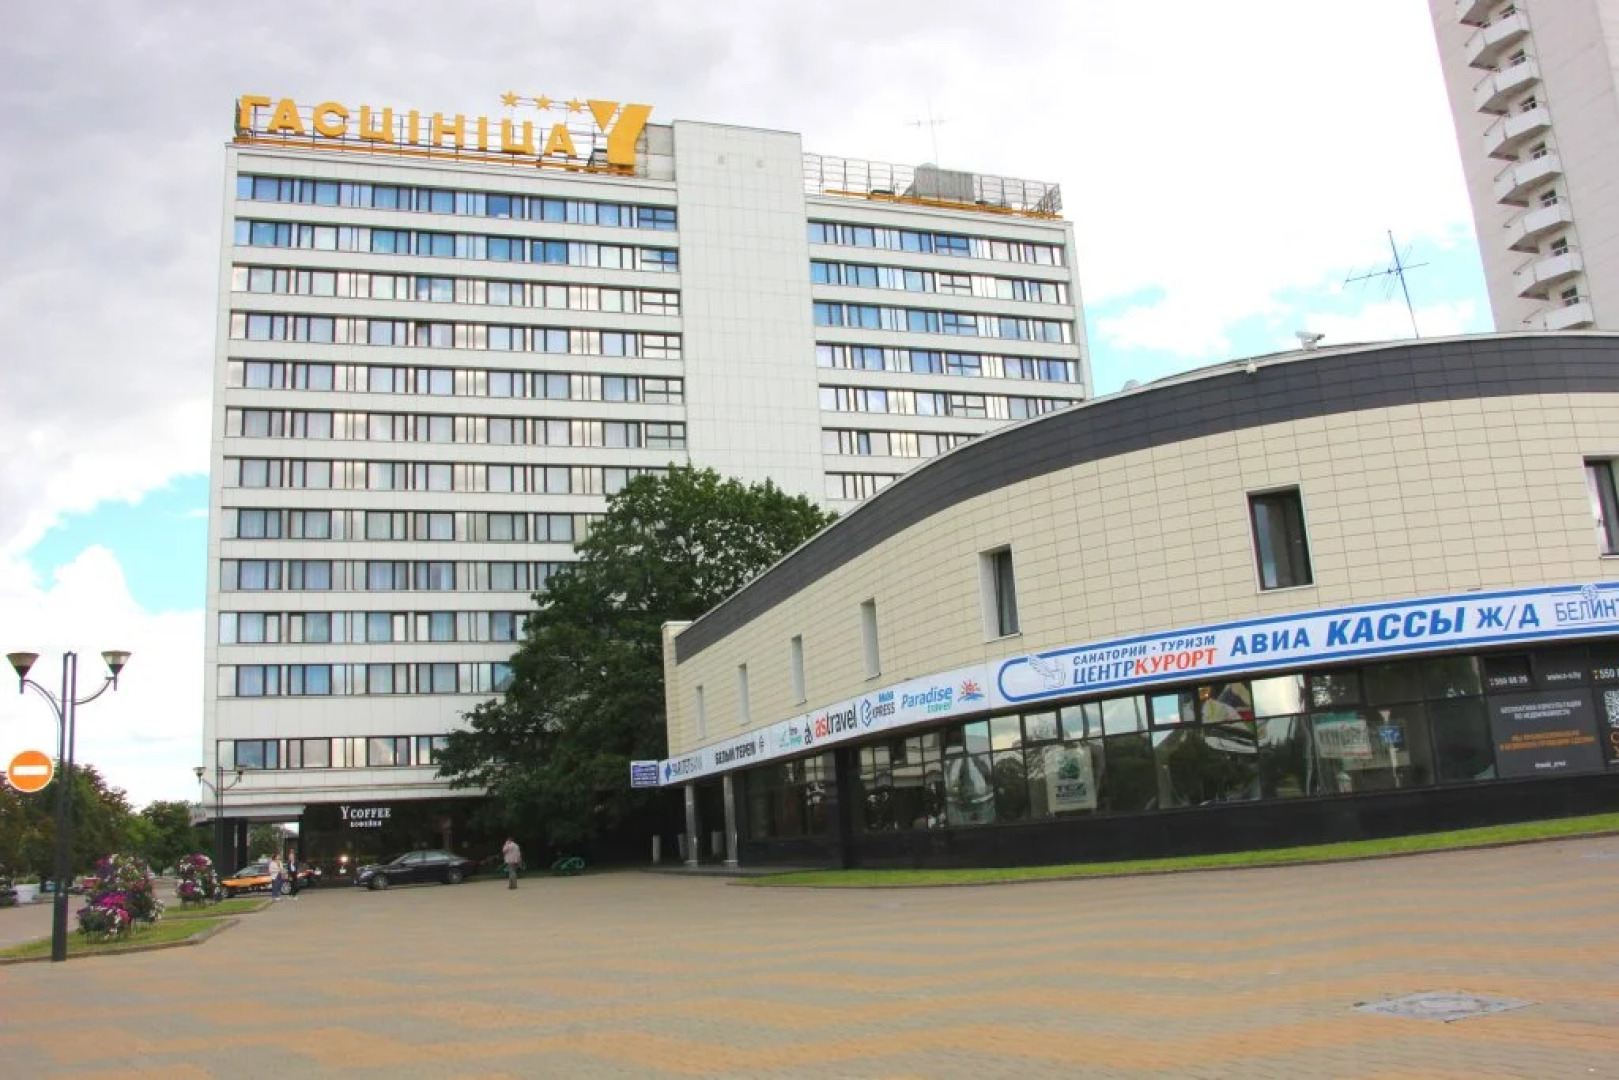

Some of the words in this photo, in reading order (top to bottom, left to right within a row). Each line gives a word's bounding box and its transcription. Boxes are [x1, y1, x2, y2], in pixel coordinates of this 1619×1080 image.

[238, 95, 577, 158] ГАСЦІНІЦА
[1555, 598, 1619, 622] БЕЛИН
[1230, 627, 1310, 657] АВИА
[1326, 606, 1466, 648] КАССЫ
[1476, 603, 1541, 632] Ж/Д
[1073, 644, 1147, 666] САНАТОРИИ
[1160, 635, 1216, 652] ТУРИЗМ
[901, 686, 953, 709] Paradise
[815, 704, 858, 738] astravel
